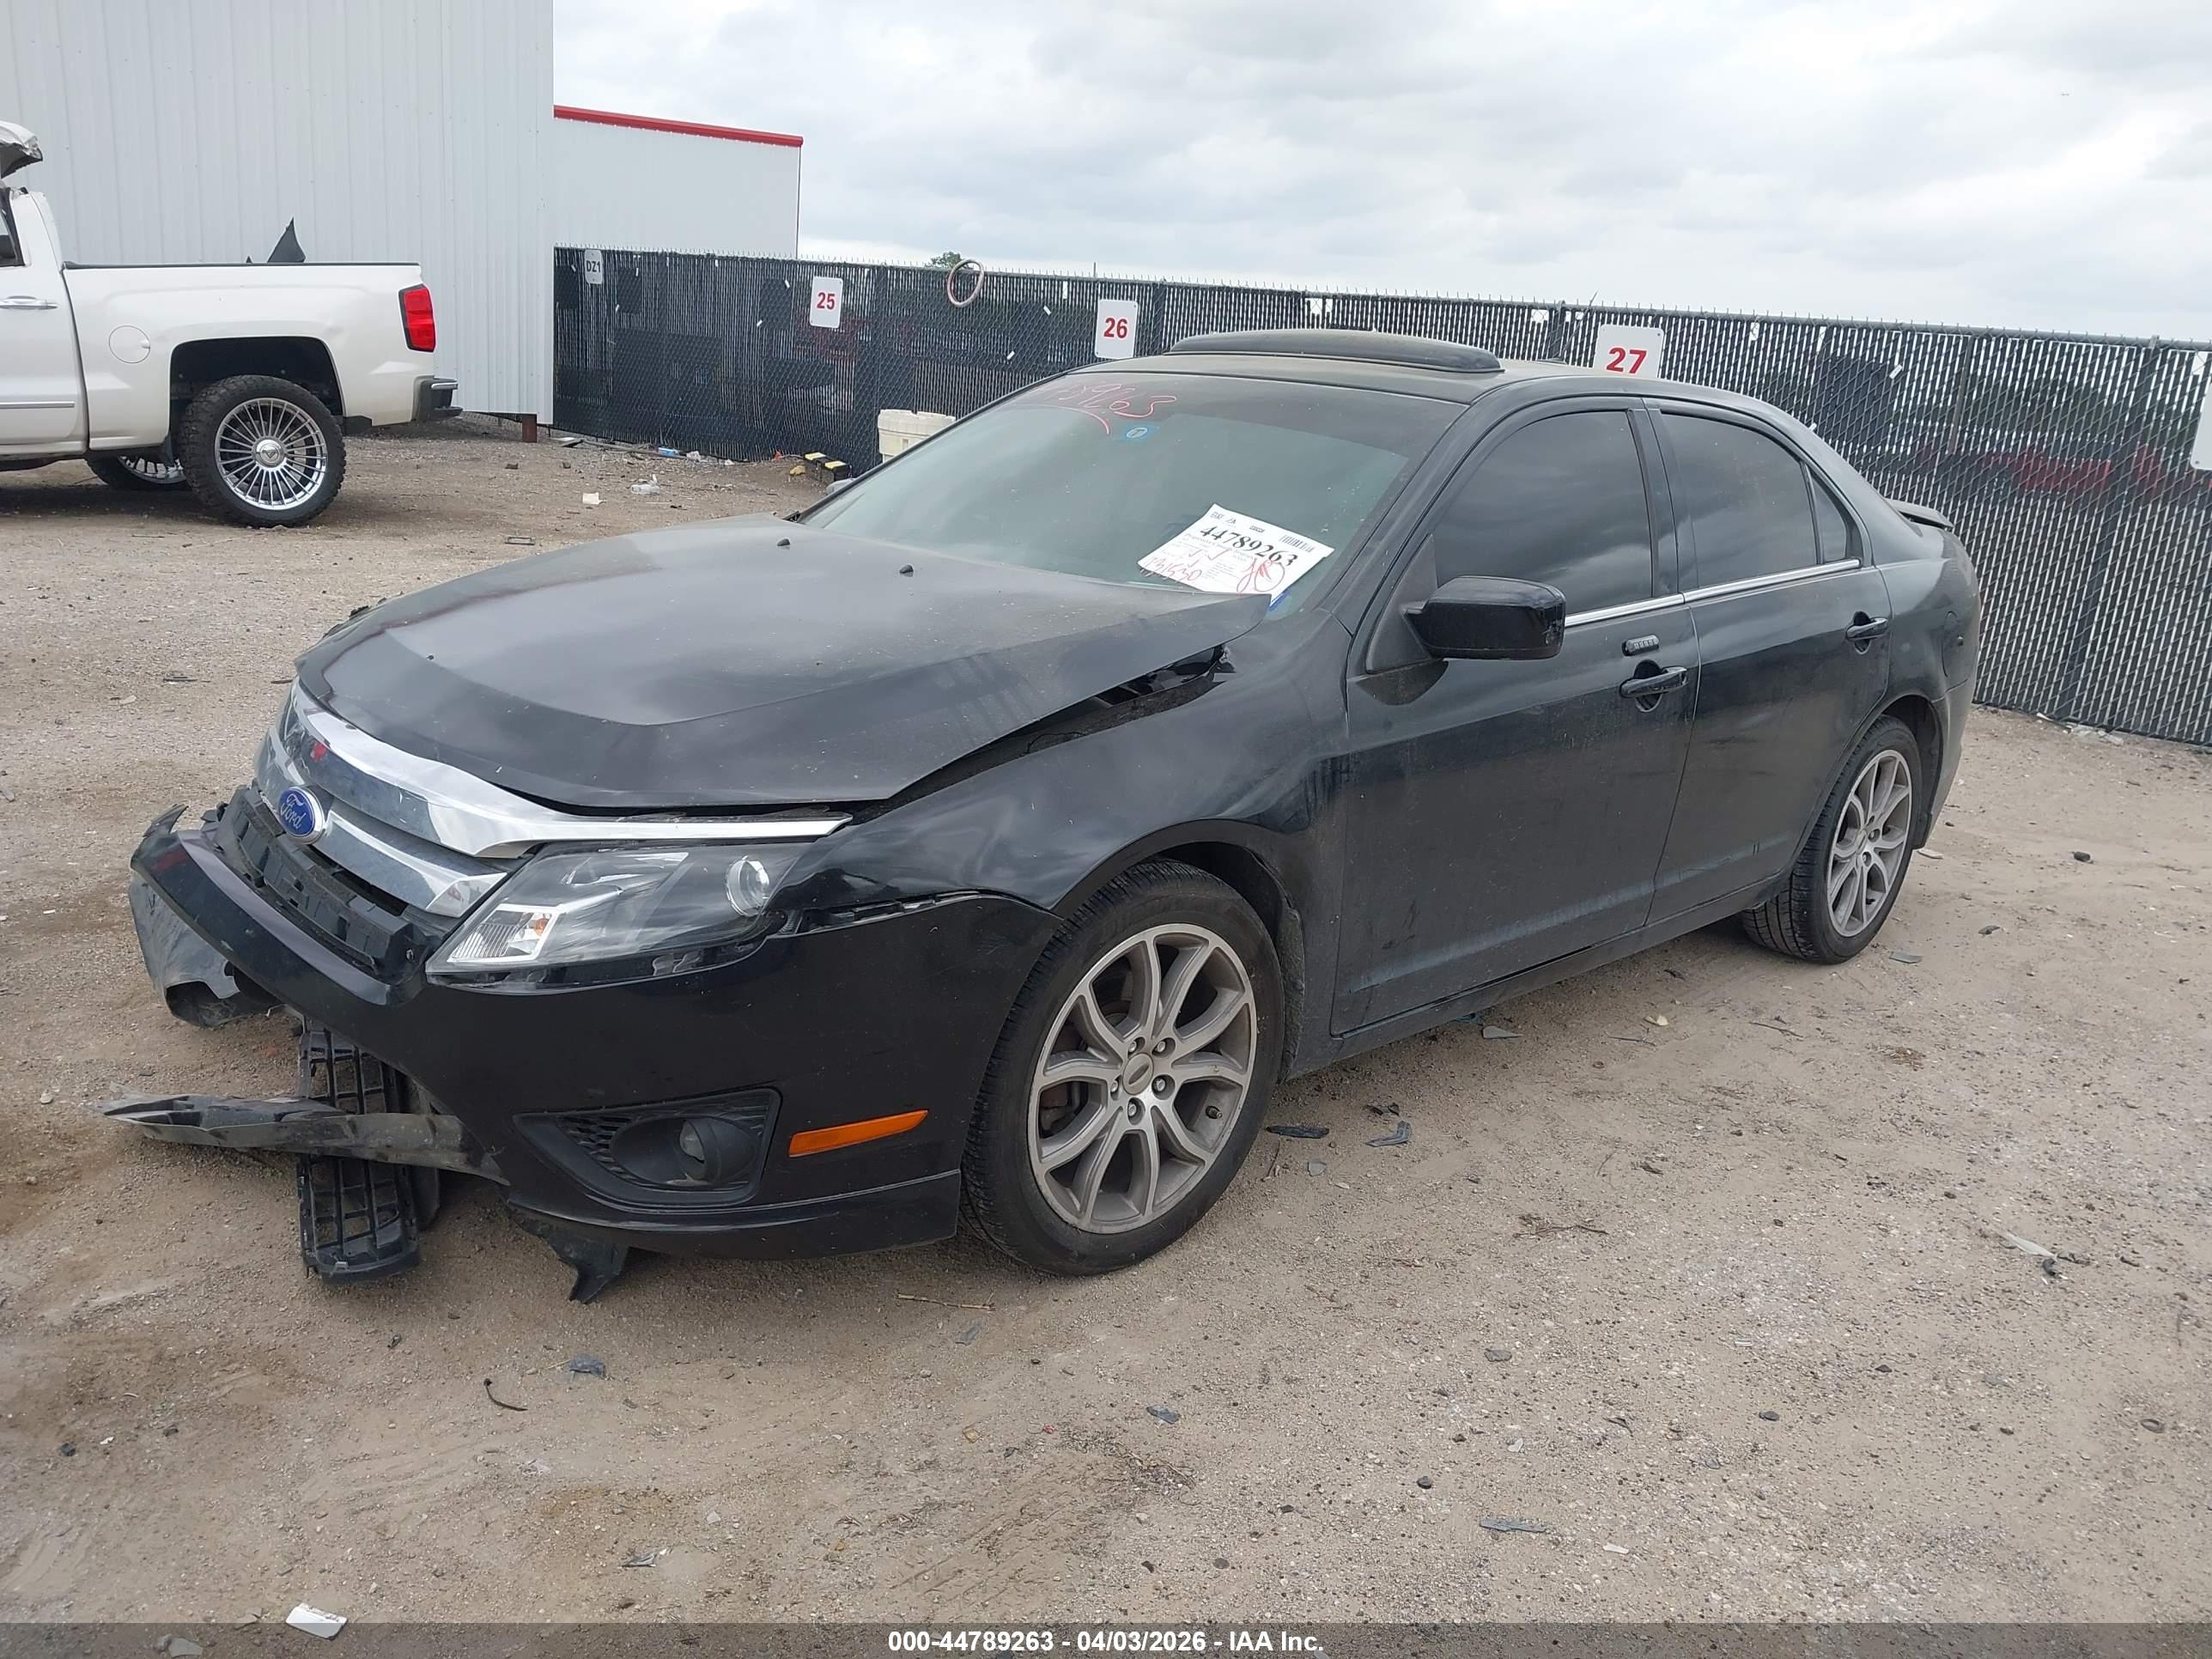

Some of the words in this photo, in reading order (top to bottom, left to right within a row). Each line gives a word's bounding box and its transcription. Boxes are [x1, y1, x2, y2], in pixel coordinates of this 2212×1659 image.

[586, 260, 601, 273] DZ1
[817, 292, 836, 310] 25
[1103, 317, 1127, 338] 26
[1606, 347, 1648, 374] 27
[1199, 526, 1298, 568] 44789263
[280, 793, 307, 830] Ford
